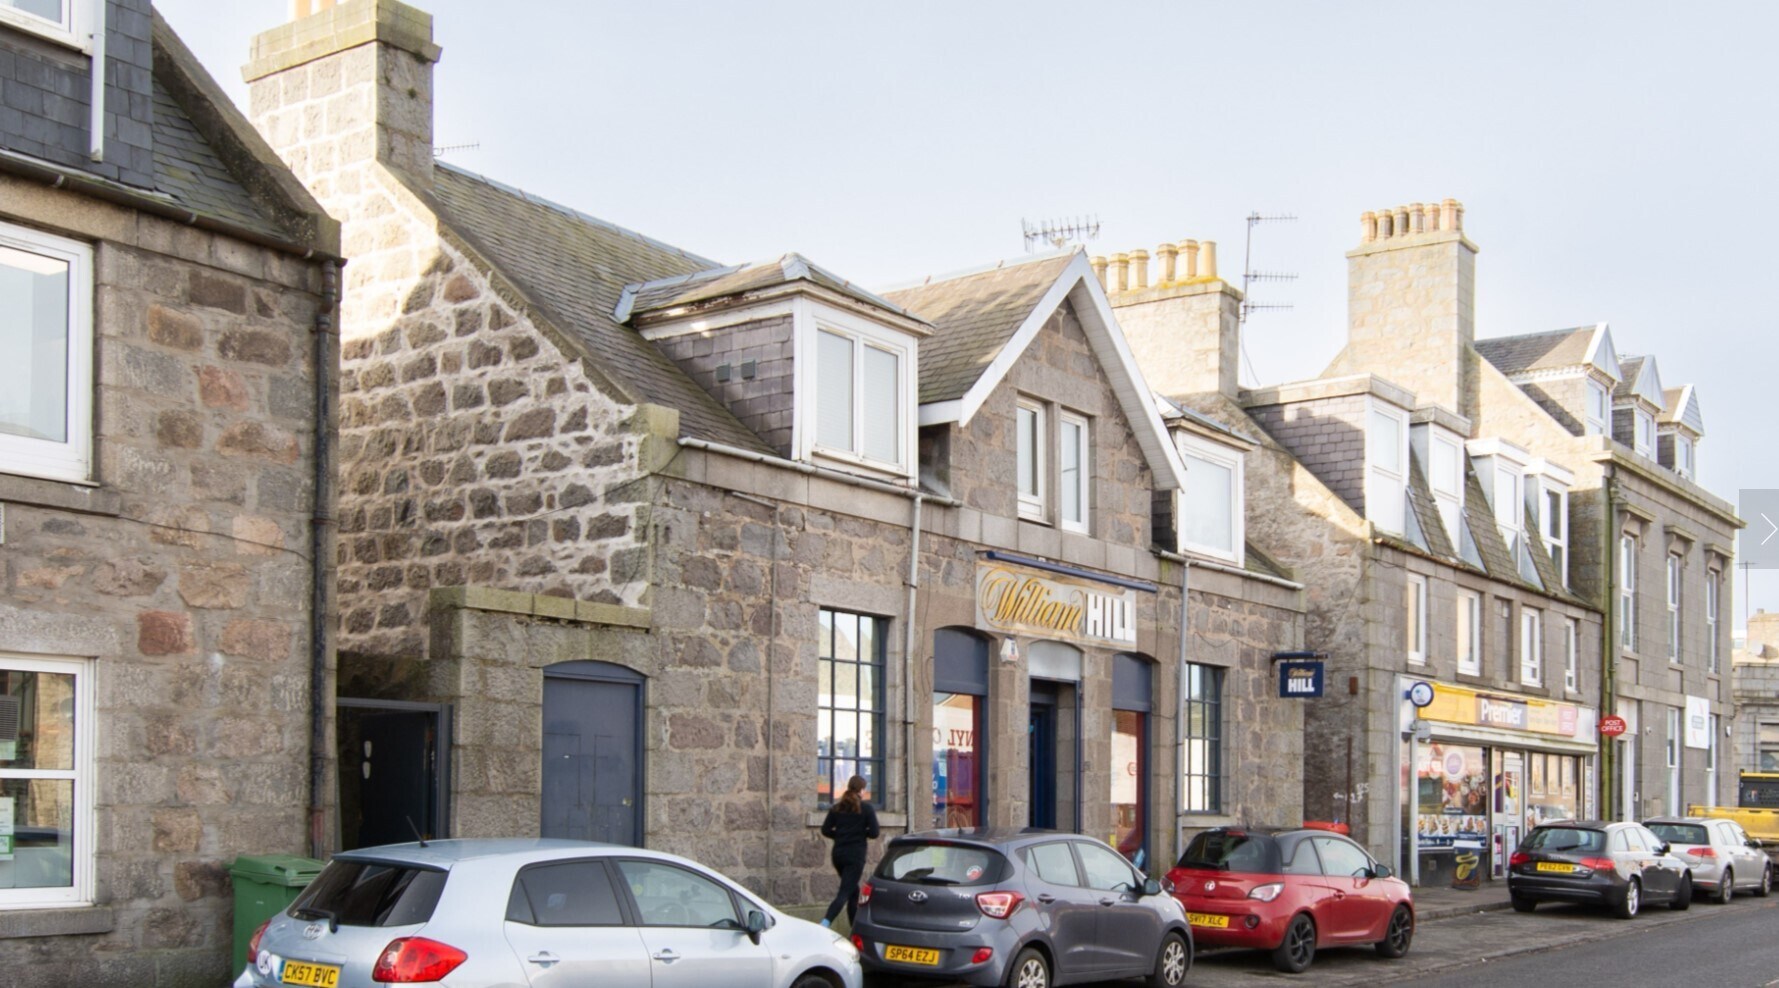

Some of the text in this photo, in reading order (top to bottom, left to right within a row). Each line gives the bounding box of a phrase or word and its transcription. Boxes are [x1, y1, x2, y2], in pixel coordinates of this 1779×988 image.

[981, 568, 1136, 642] William HILL
[1288, 678, 1315, 693] HILL
[1480, 700, 1522, 725] Premier
[889, 948, 936, 963] SP64 EZJ
[284, 963, 336, 985] CK57 BVC
